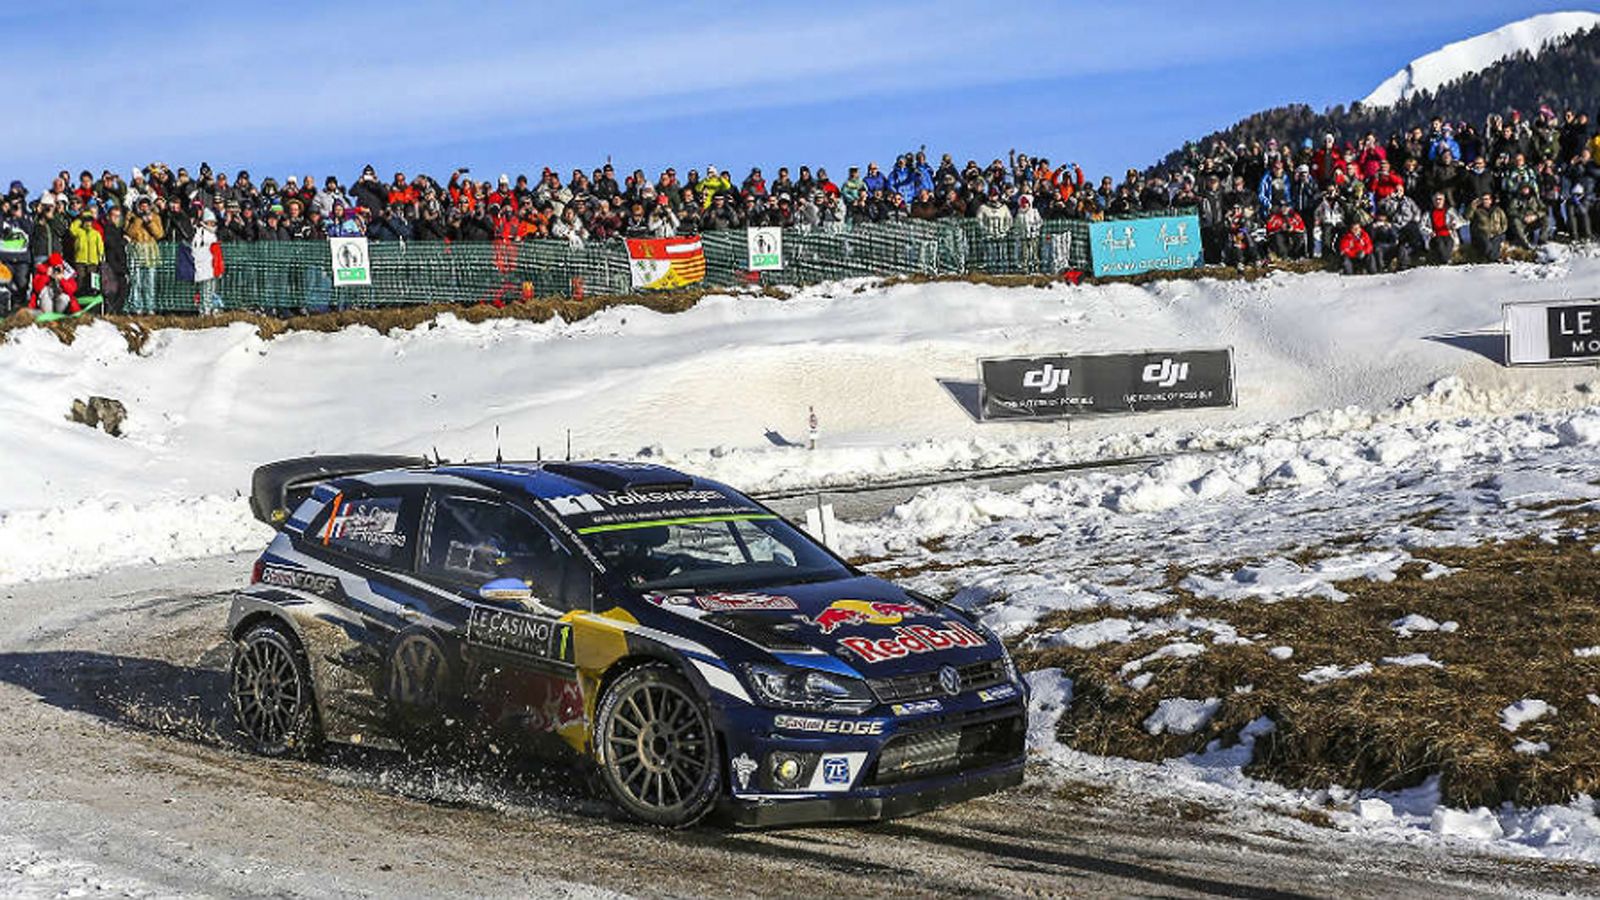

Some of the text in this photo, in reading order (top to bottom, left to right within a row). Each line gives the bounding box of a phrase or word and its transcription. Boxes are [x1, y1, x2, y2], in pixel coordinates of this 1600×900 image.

[1560, 311, 1593, 335] LE
[473, 609, 549, 641] LE CASINO
[560, 626, 570, 660] 1
[839, 620, 987, 664] Red Bull
[822, 719, 885, 735] EDGE
